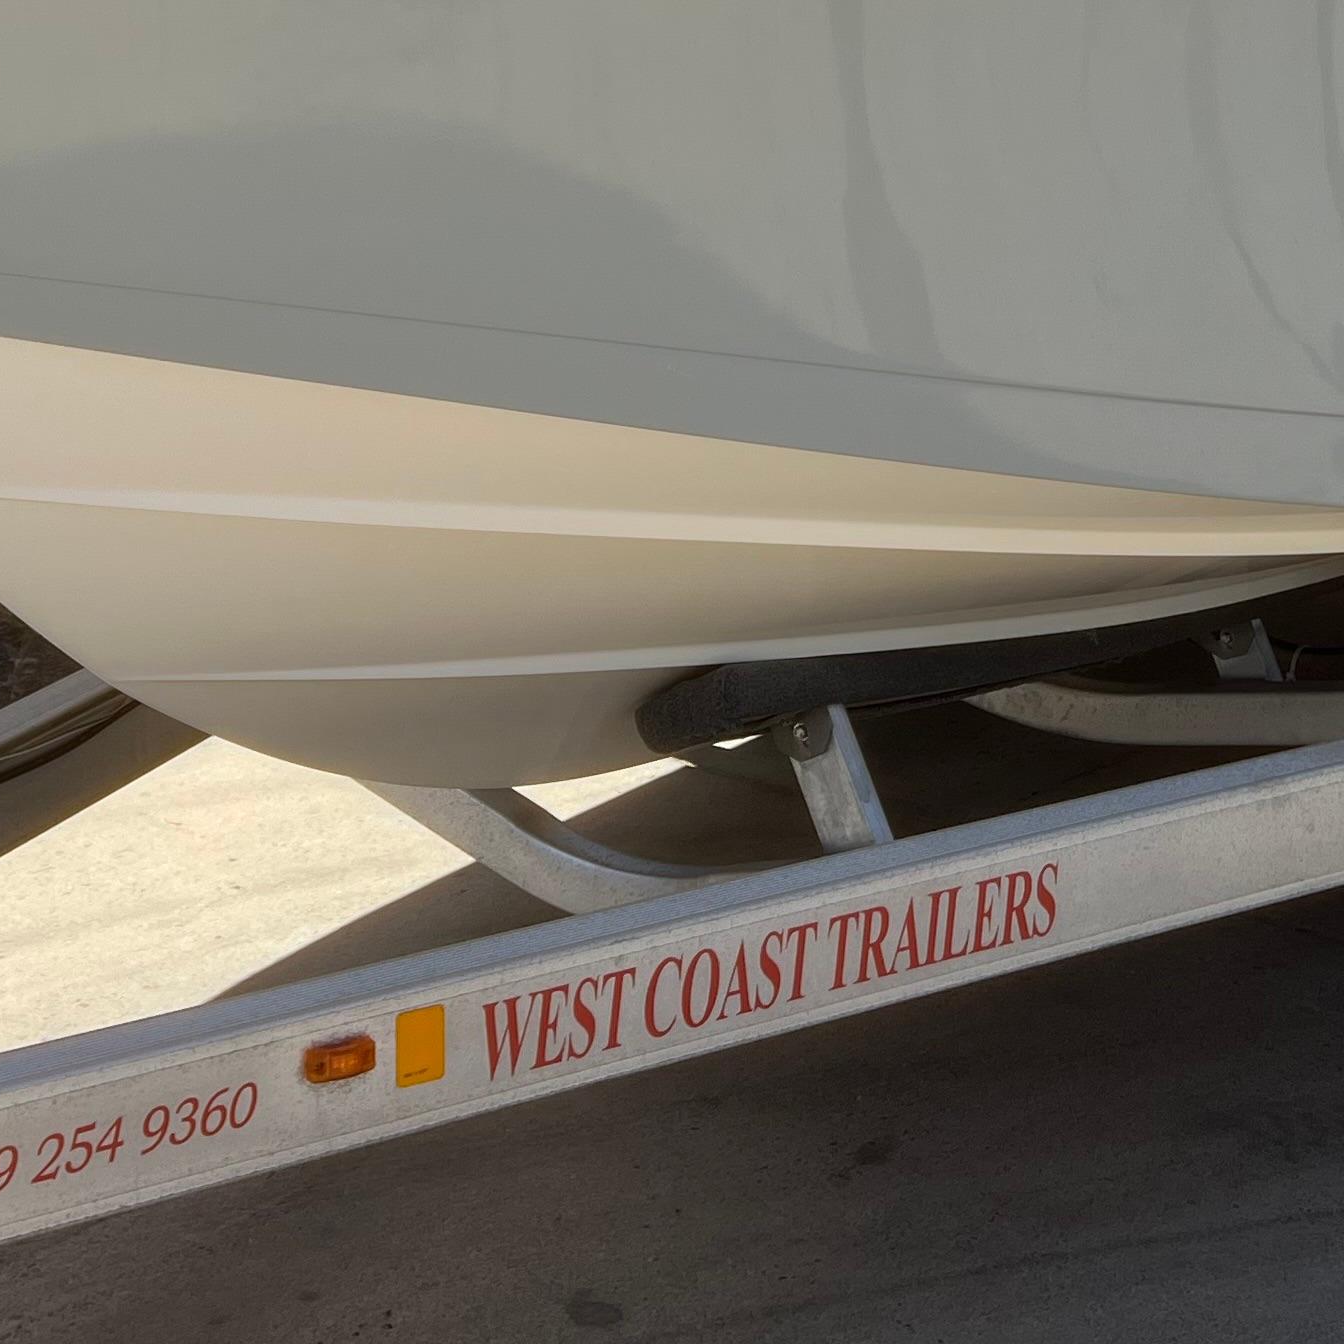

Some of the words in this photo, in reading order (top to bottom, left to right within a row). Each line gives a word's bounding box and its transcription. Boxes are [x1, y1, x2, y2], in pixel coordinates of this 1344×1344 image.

[482, 967, 637, 1083] WEST
[644, 921, 818, 1039] COAST
[828, 862, 1059, 991] TRAILERS
[31, 1115, 124, 1184] 254
[141, 1082, 258, 1156] 9360
